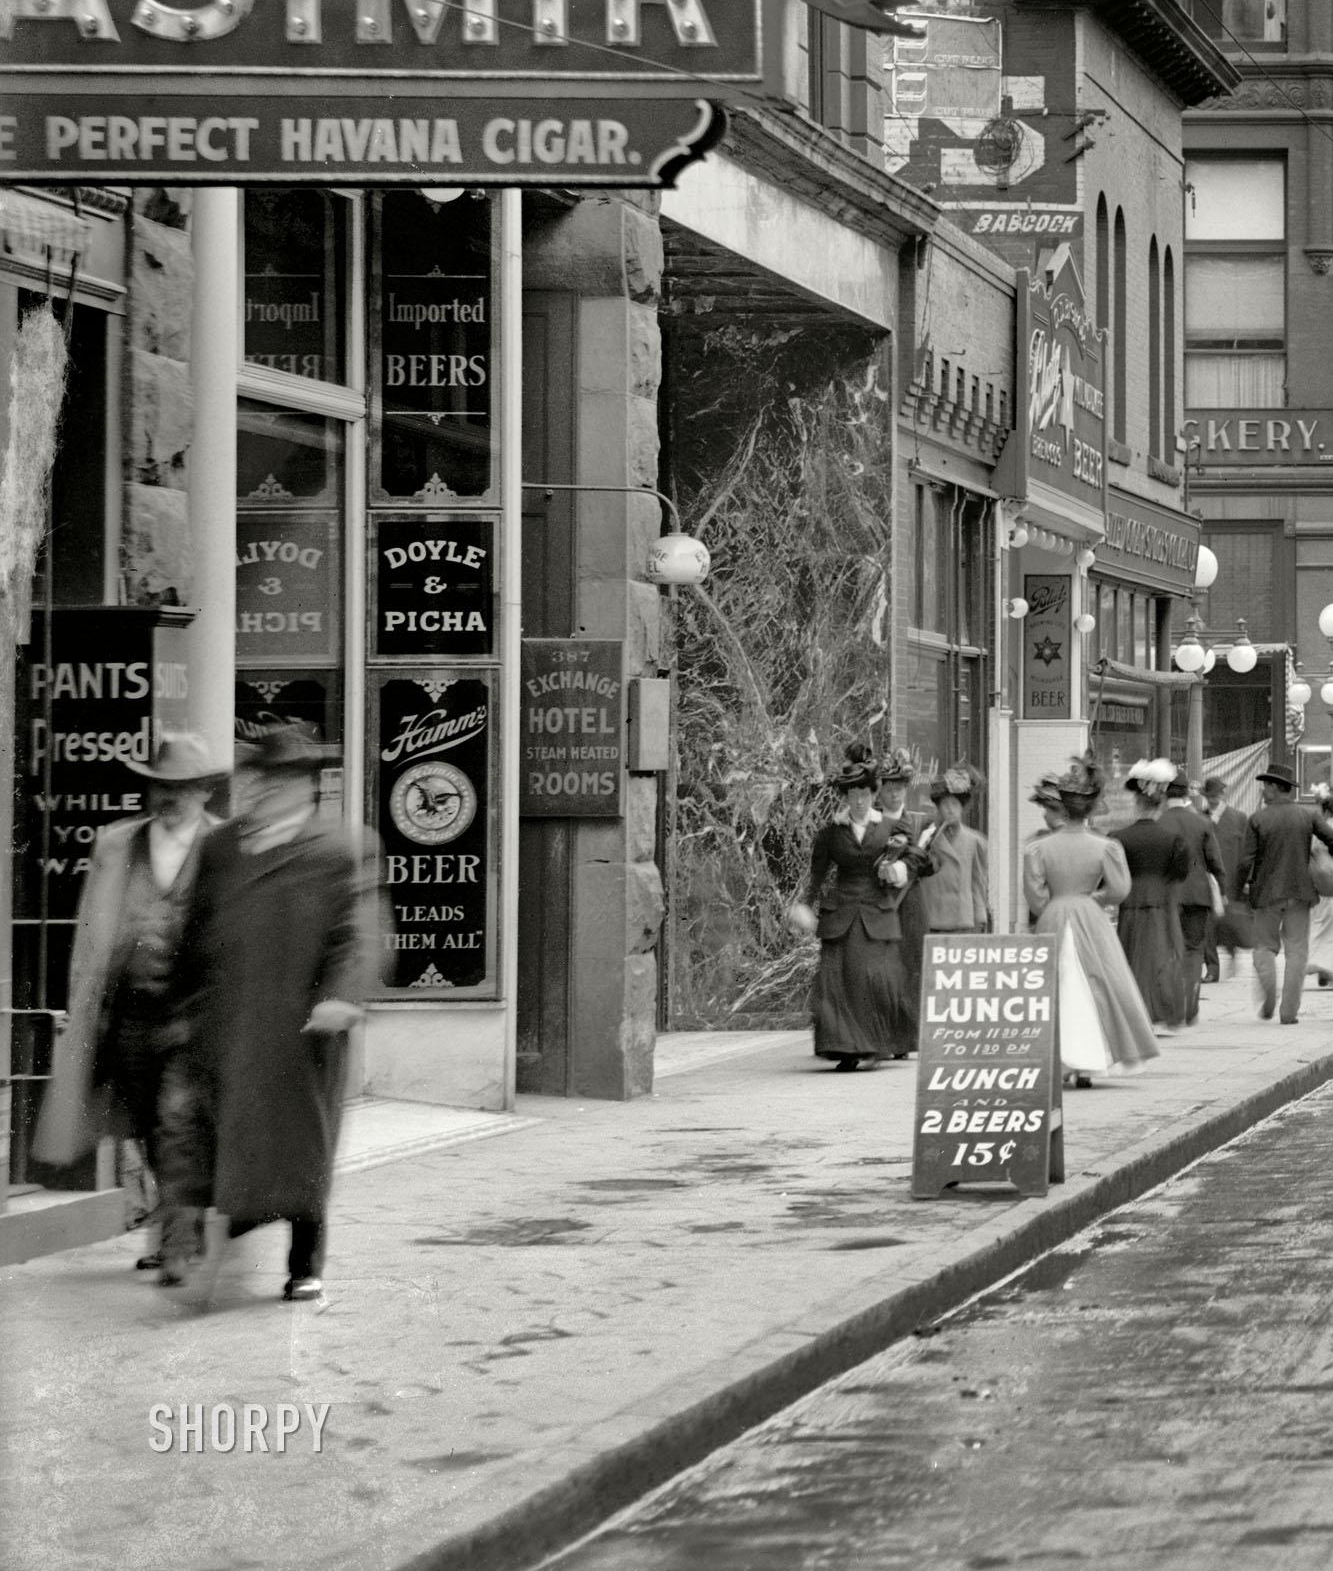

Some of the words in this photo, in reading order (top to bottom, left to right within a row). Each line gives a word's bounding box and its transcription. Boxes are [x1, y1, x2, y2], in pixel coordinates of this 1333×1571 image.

[46, 117, 259, 163] PERFECT
[281, 118, 463, 163] HAVANA
[482, 118, 642, 166] CIGAR.
[972, 213, 1080, 234] BABCOCK
[388, 292, 485, 330] Imported
[386, 355, 487, 387] BEERS
[384, 540, 487, 569] DOYLE
[424, 576, 447, 594] &
[384, 610, 487, 632] PICHA
[551, 650, 592, 663] 387
[31, 662, 150, 700] PANTS
[526, 670, 621, 700] EXCHANGE
[1031, 689, 1066, 708] BEER
[529, 707, 615, 734] HOTEL
[526, 746, 567, 761] STEAM
[570, 746, 619, 761] HEATED
[529, 771, 616, 796] ROOMS
[34, 792, 143, 812] WHILE
[52, 825, 103, 844] YO
[37, 857, 91, 876] WA
[386, 854, 481, 885] BEER
[382, 933, 437, 950] THEM
[931, 945, 1049, 965] BUSINESS
[934, 967, 1045, 990] MEN'S
[925, 996, 1051, 1023] LUNCH
[927, 1066, 1042, 1091] LUNCH
[952, 1098, 1008, 1107] AND
[920, 1109, 945, 1134] 2
[946, 1109, 1046, 1133] BEERS
